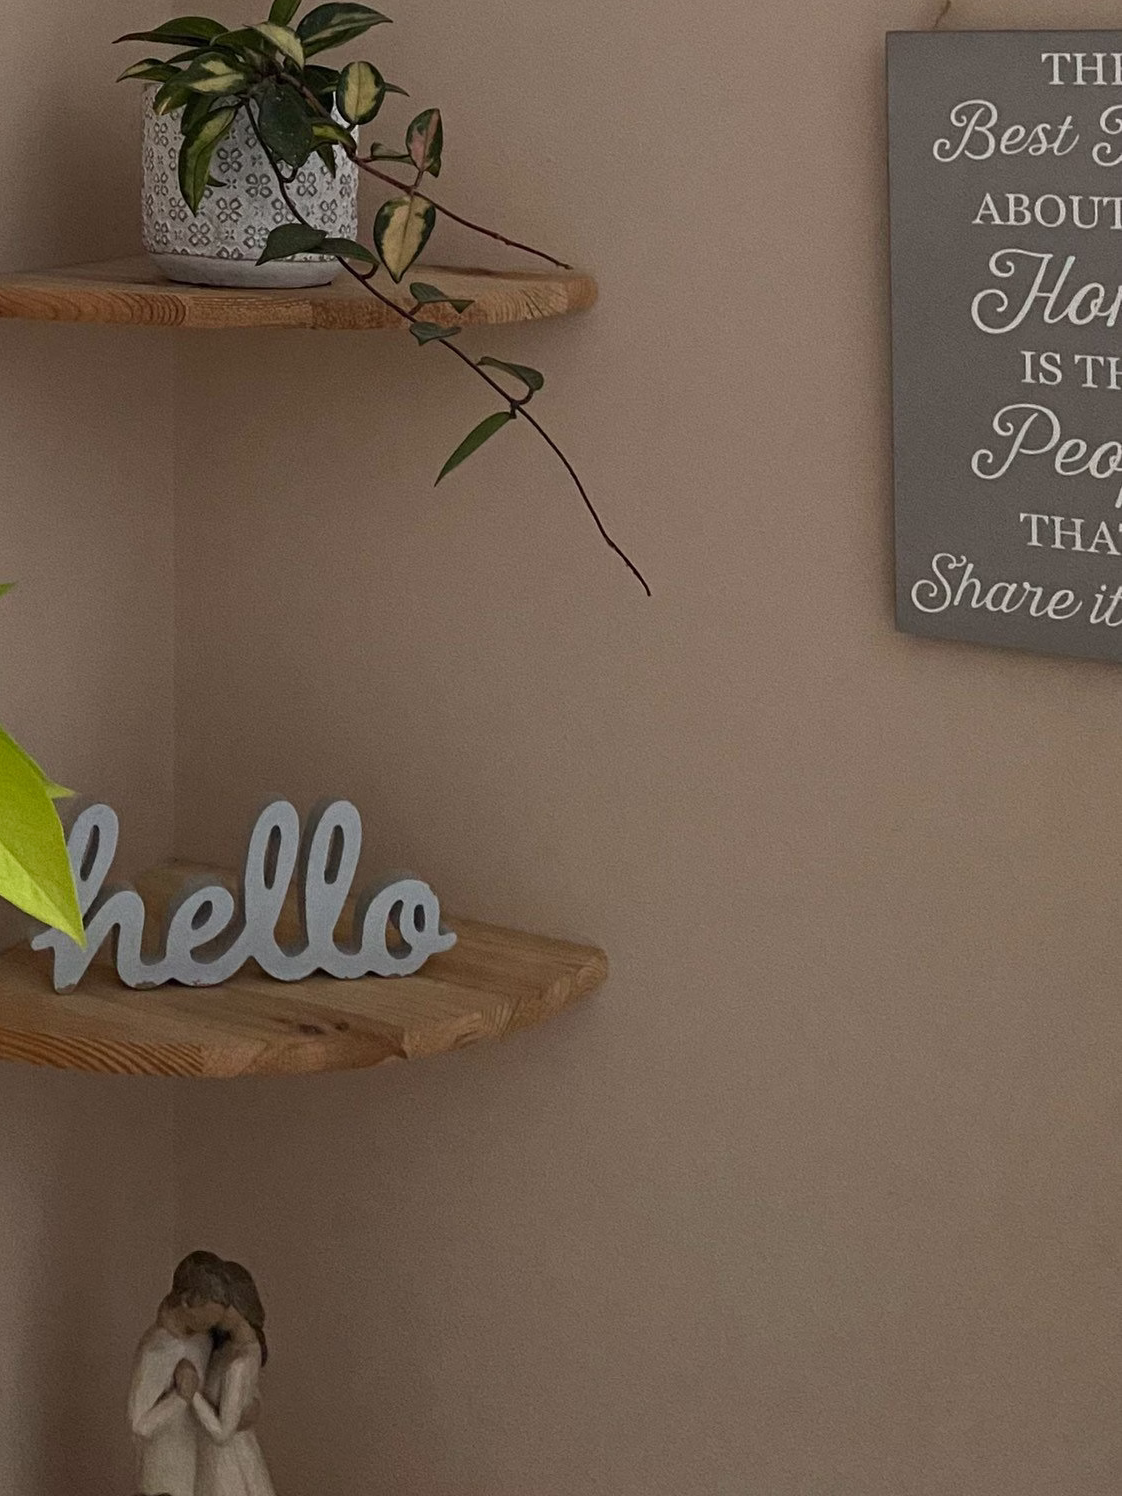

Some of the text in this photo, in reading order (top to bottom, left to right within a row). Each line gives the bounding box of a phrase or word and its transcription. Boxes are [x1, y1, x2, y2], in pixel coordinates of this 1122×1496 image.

[932, 98, 1079, 163] Best
[971, 192, 1122, 230] ABOUT
[970, 248, 1122, 335] Ho
[1020, 350, 1063, 386] IS
[971, 403, 1122, 509] Peo
[1019, 512, 1122, 556] THA
[911, 552, 1083, 620] Share
[30, 799, 458, 995] hello
